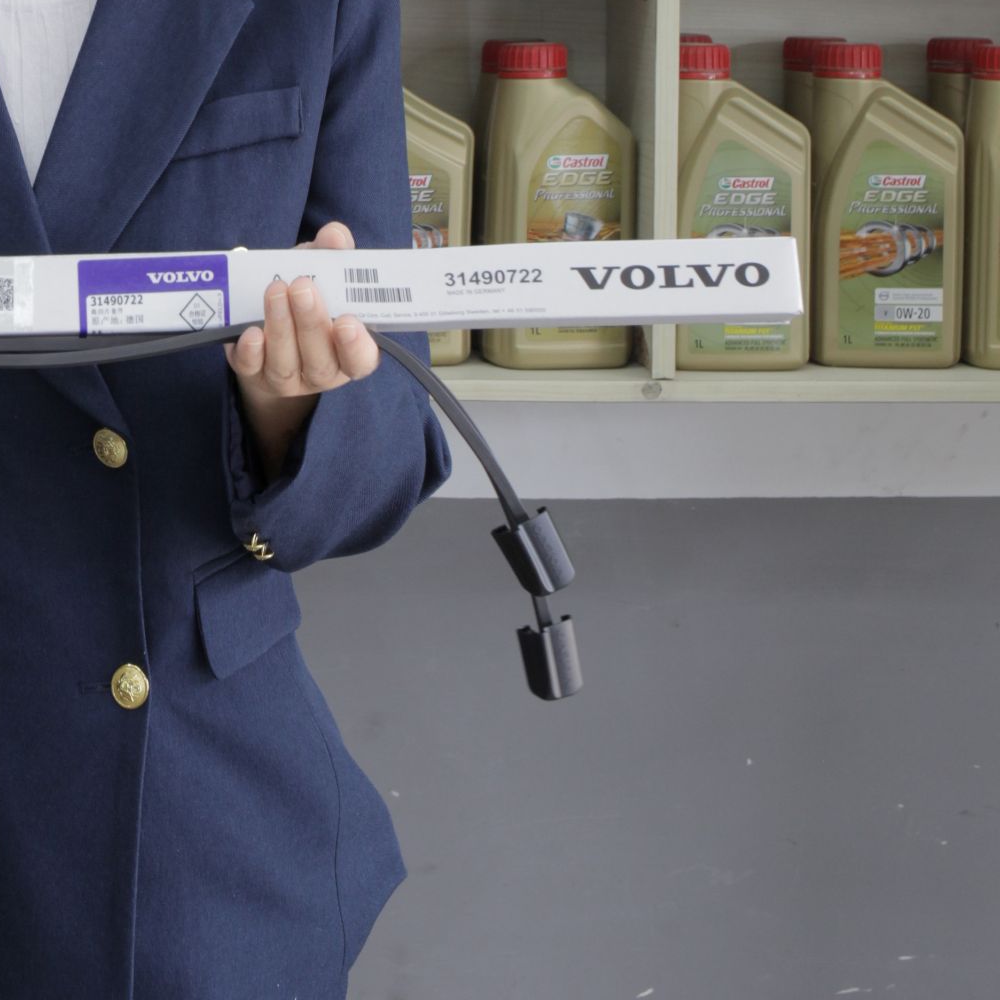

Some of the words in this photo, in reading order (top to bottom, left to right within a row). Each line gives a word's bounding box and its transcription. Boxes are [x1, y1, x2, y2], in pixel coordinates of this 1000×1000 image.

[562, 155, 604, 168] Castrol
[542, 172, 611, 186] EDGE
[732, 178, 770, 189] Castrol
[882, 176, 921, 187] Castrol
[713, 192, 776, 204] EDGE
[863, 191, 927, 202] EDGE
[146, 270, 214, 284] VOLVO
[444, 268, 543, 286] 31490722
[570, 262, 770, 290] VOLVO
[91, 294, 143, 306] 31490722
[896, 307, 930, 319] 0W-20
